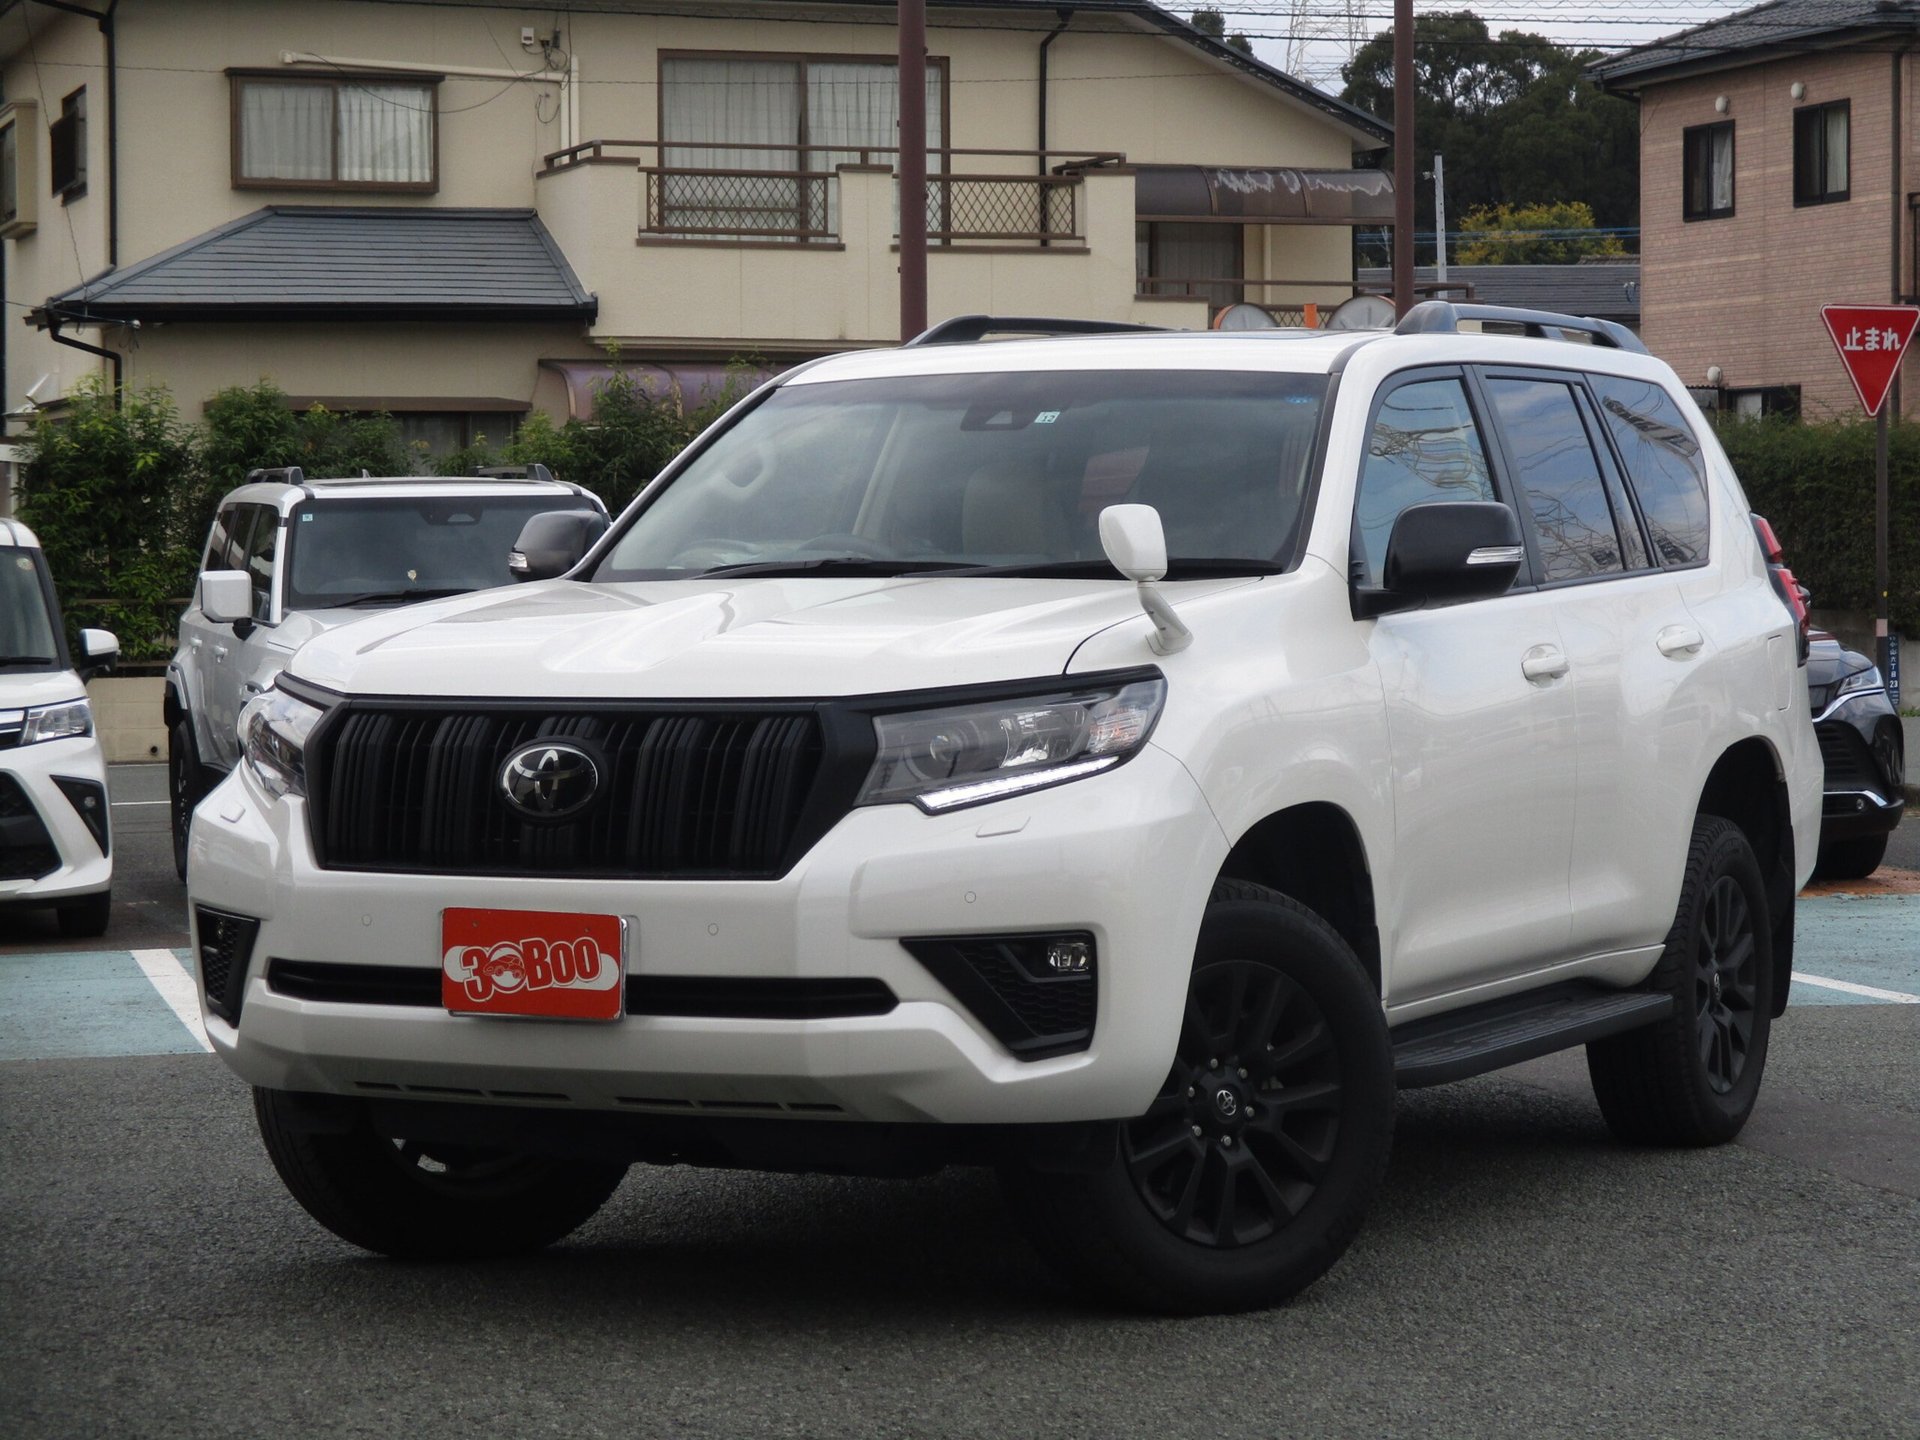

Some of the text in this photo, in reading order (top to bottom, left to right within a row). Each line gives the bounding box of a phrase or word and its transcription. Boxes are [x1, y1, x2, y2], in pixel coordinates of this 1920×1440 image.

[1843, 326, 1901, 351] 止まれ
[1889, 680, 1898, 688] 23
